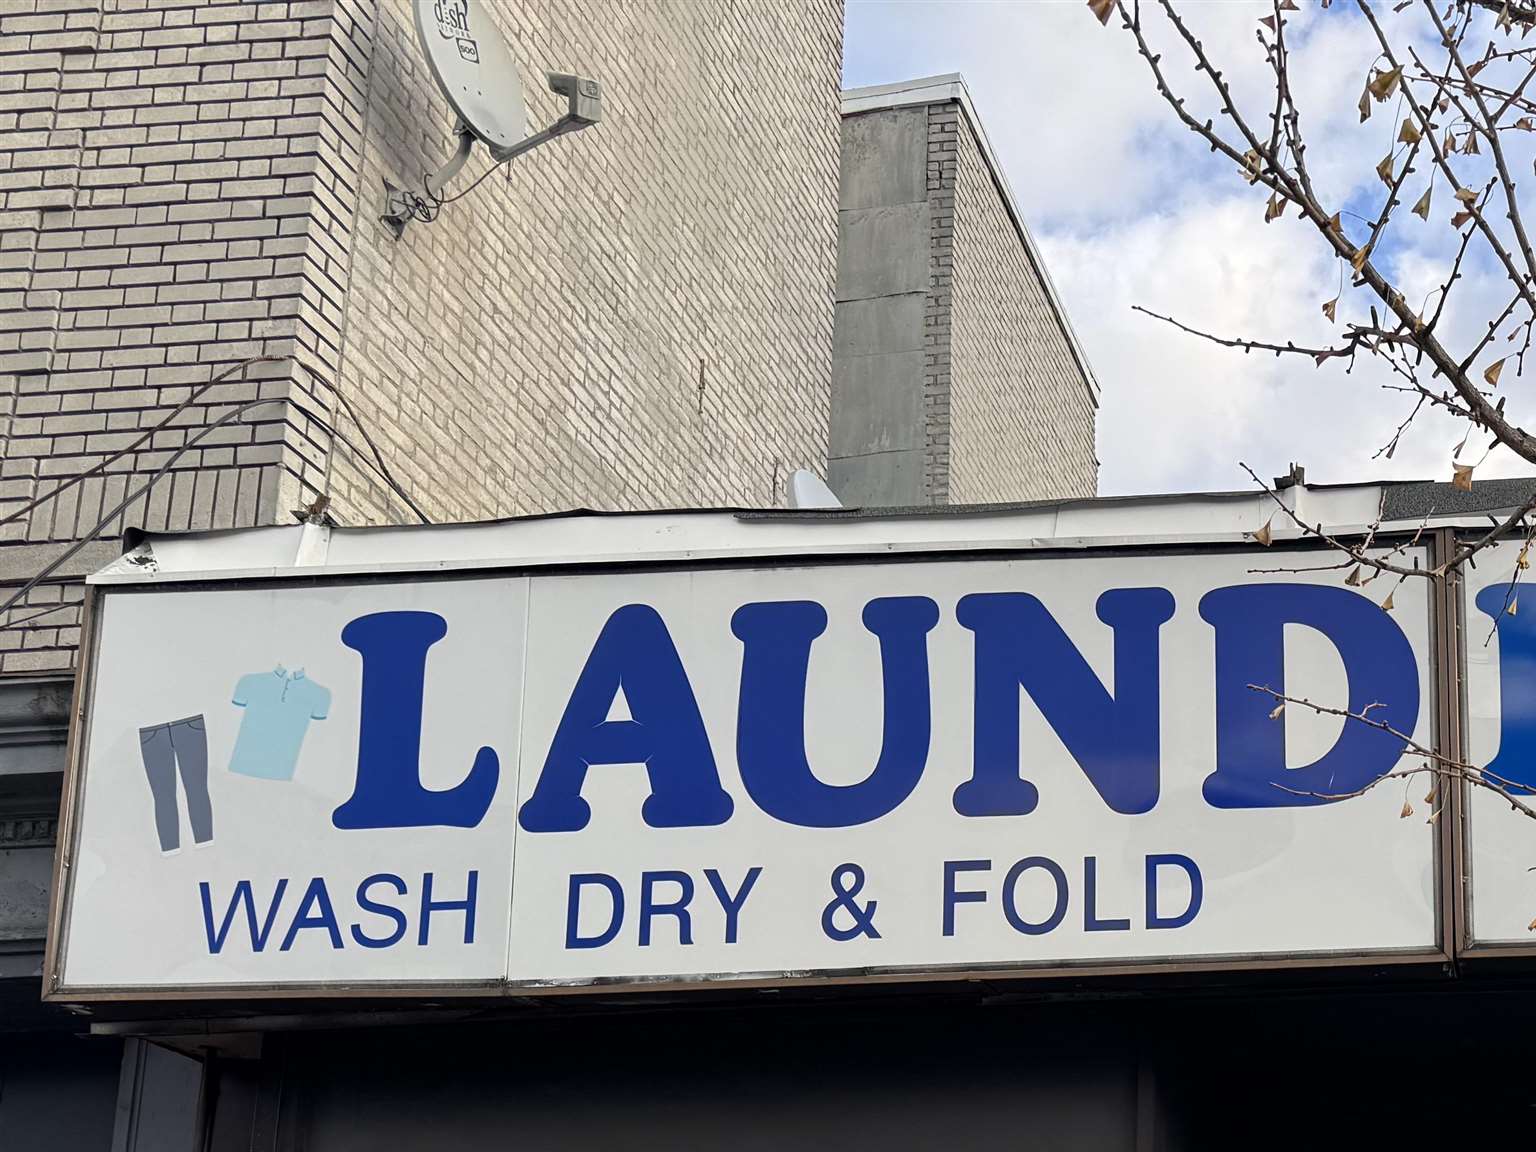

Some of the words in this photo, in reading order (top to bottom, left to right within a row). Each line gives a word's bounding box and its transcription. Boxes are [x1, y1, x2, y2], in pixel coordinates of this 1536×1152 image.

[459, 45, 475, 55] 500
[200, 870, 479, 954] WASH
[564, 867, 764, 950] DRY
[824, 869, 878, 940] &
[944, 854, 1204, 937] FOLD
